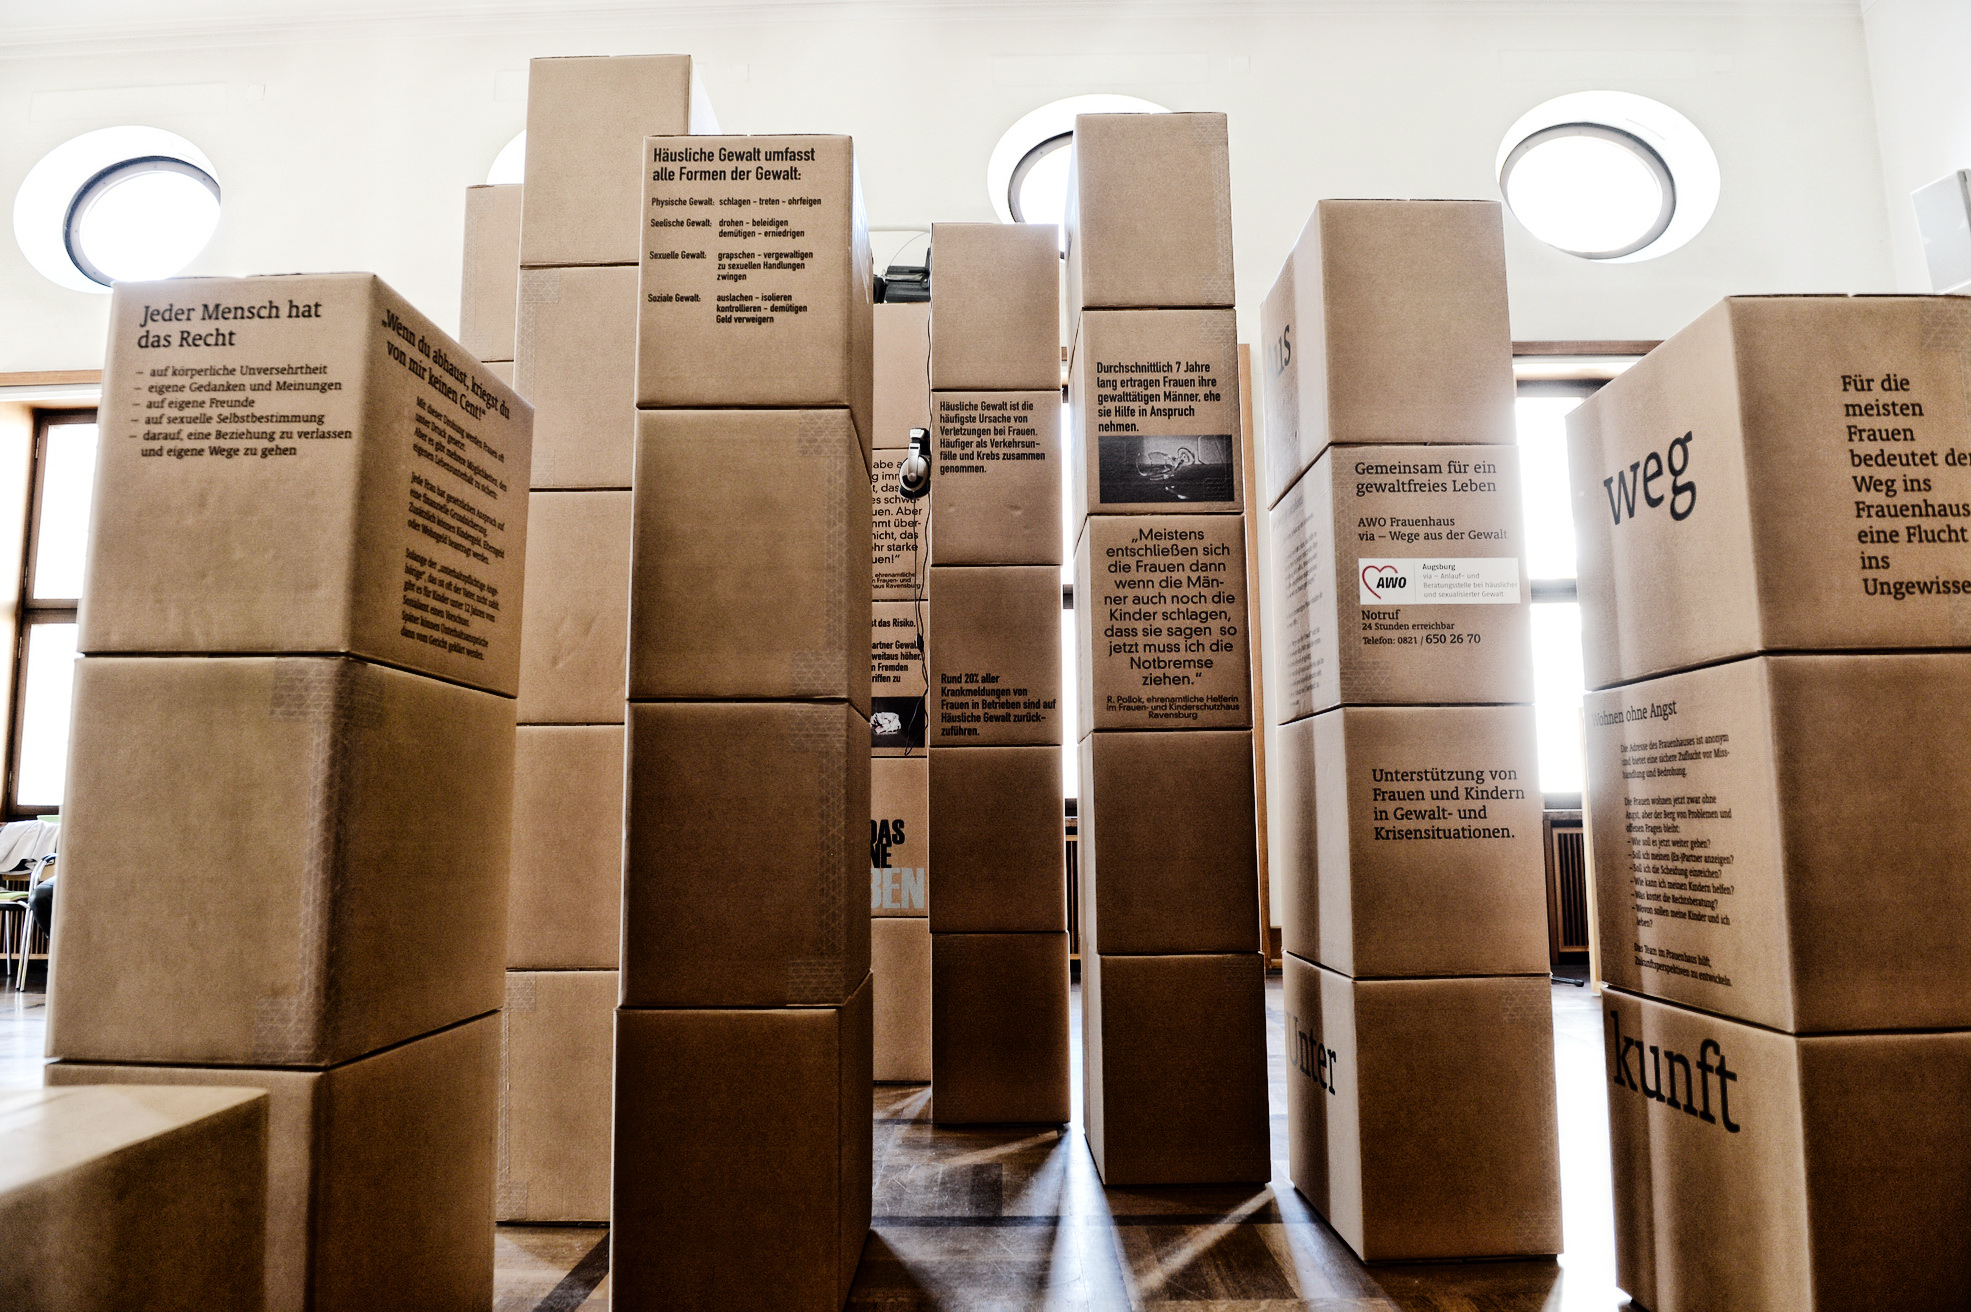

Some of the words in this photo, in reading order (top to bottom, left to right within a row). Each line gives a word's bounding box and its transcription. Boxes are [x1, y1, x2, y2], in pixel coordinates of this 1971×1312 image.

[654, 148, 714, 162] Häusliche
[719, 147, 761, 161] Gewalt
[765, 147, 815, 161] umfasst
[653, 167, 675, 181] alle
[680, 167, 726, 181] Formen
[731, 166, 752, 180] der
[756, 166, 801, 180] Gewalt:
[652, 197, 687, 208] Physische
[689, 197, 714, 206] Gewalt:
[719, 197, 751, 207] schlagen
[788, 197, 821, 207] ohrfeigen
[651, 219, 684, 228] Seelische
[686, 218, 712, 228] Gewalt:
[719, 219, 743, 228] drohen
[752, 218, 788, 229] beleidigen
[649, 251, 679, 259] Sexuelle
[681, 251, 706, 259] Gewalt:
[718, 251, 755, 261] grapschen
[764, 250, 813, 260] vergewaltigen
[140, 303, 195, 328] Jeder
[201, 301, 280, 320] Mensch
[287, 300, 322, 318] hat
[137, 330, 171, 348] das
[179, 328, 236, 347] Recht
[150, 368, 168, 377] auf
[172, 366, 236, 377] körperliche
[240, 364, 327, 375] Unversehrtheit
[387, 341, 406, 366] von
[408, 360, 427, 380] mir
[428, 367, 457, 404] keinen
[1097, 362, 1172, 373] Durchschnittlich
[1176, 361, 1181, 372] 7
[1184, 361, 1210, 372] Jahre
[418, 336, 430, 358] du
[432, 349, 469, 390] abhaust,
[471, 376, 498, 411] kriegst
[500, 400, 510, 420] du
[1097, 377, 1117, 391] lang
[1120, 377, 1160, 390] ertragen
[1163, 376, 1195, 387] Frauen
[1198, 376, 1216, 387] ihre
[1841, 375, 1874, 392] Für
[1881, 374, 1910, 392] die
[148, 385, 185, 394] eigene
[189, 382, 245, 392] Gedanken
[250, 381, 272, 391] und
[276, 381, 342, 393] Meinungen
[1098, 391, 1160, 405] gewalttätigen
[1164, 391, 1200, 402] Männer,
[1204, 390, 1220, 401] ehe
[940, 401, 978, 411] Häusliche
[981, 401, 1008, 411] Gewalt
[1010, 401, 1019, 411] ist
[1022, 401, 1033, 410] die
[1844, 400, 1924, 417] meisten
[940, 414, 976, 426] häufigste
[979, 414, 1011, 423] Ursache
[143, 431, 183, 441] darauf,
[187, 432, 211, 440] eine
[215, 429, 276, 442] Beziehung
[279, 431, 293, 439] zu
[297, 428, 352, 439] verlassen
[940, 426, 991, 439] Verletzungen
[994, 426, 1005, 436] bei
[1008, 426, 1037, 439] Frauen.
[1847, 426, 1915, 442] Frauen
[1849, 449, 1938, 467] bedeutet
[1355, 461, 1443, 475] Gemeinsam
[1448, 461, 1469, 474] für
[1474, 461, 1496, 473] ein
[1604, 431, 1697, 525] weg
[1356, 479, 1447, 497] gewaltfreies
[1452, 479, 1496, 492] Leben
[1852, 476, 1897, 497] Weg
[1902, 474, 1931, 492] ins
[896, 507, 922, 516] Aber
[1855, 500, 1970, 518] Frauenhaus
[1358, 517, 1386, 527] AWO
[1390, 517, 1455, 527] Frauenhaus
[1132, 528, 1204, 543] „Meistens
[1358, 531, 1375, 541] via
[1389, 531, 1420, 543] Wege
[1424, 532, 1442, 540] aus
[1446, 530, 1465, 540] der
[1468, 530, 1508, 540] Gewalt
[1858, 526, 1899, 544] eine
[1906, 525, 1968, 543] Flucht
[887, 543, 919, 551] starke
[1106, 544, 1198, 557] entschließen
[1203, 543, 1230, 556] sich
[1422, 563, 1456, 571] Augsburg
[1377, 577, 1406, 588] AWO
[1110, 608, 1158, 621] Kinder
[1162, 608, 1231, 623] schlagen,
[1362, 609, 1400, 620] Notruf
[878, 619, 890, 627] das
[892, 618, 916, 628] Risiko.
[1375, 622, 1409, 630] Stunden
[1412, 622, 1455, 630] erreichbar
[1363, 636, 1395, 644] Telefon:
[1426, 634, 1446, 644] 650
[1450, 634, 1463, 643] 26
[1467, 634, 1480, 643] 70
[872, 651, 898, 660] weitaus
[878, 663, 908, 671] Fremden
[1130, 656, 1213, 669] Notbremse
[941, 673, 962, 684] Rund
[964, 673, 979, 683] 20%
[981, 673, 1000, 683] aller
[941, 686, 1011, 699] Krankmeldungen
[1013, 688, 1027, 696] von
[1117, 695, 1144, 704] Pollok,
[1147, 695, 1204, 703] ehrenamtliche
[1149, 711, 1198, 720] Ravensburg
[1626, 706, 1647, 721] ohne
[1650, 700, 1677, 720] Angst
[941, 712, 981, 723] Häusliche
[983, 712, 1011, 723] Gewalt
[1013, 712, 1046, 722] zurück-
[1372, 768, 1485, 784] Unterstützung
[1489, 770, 1517, 780] von
[1374, 825, 1514, 840] Krisensituationen.
[1287, 1012, 1337, 1096] Unter
[1610, 1011, 1740, 1133] kunft
